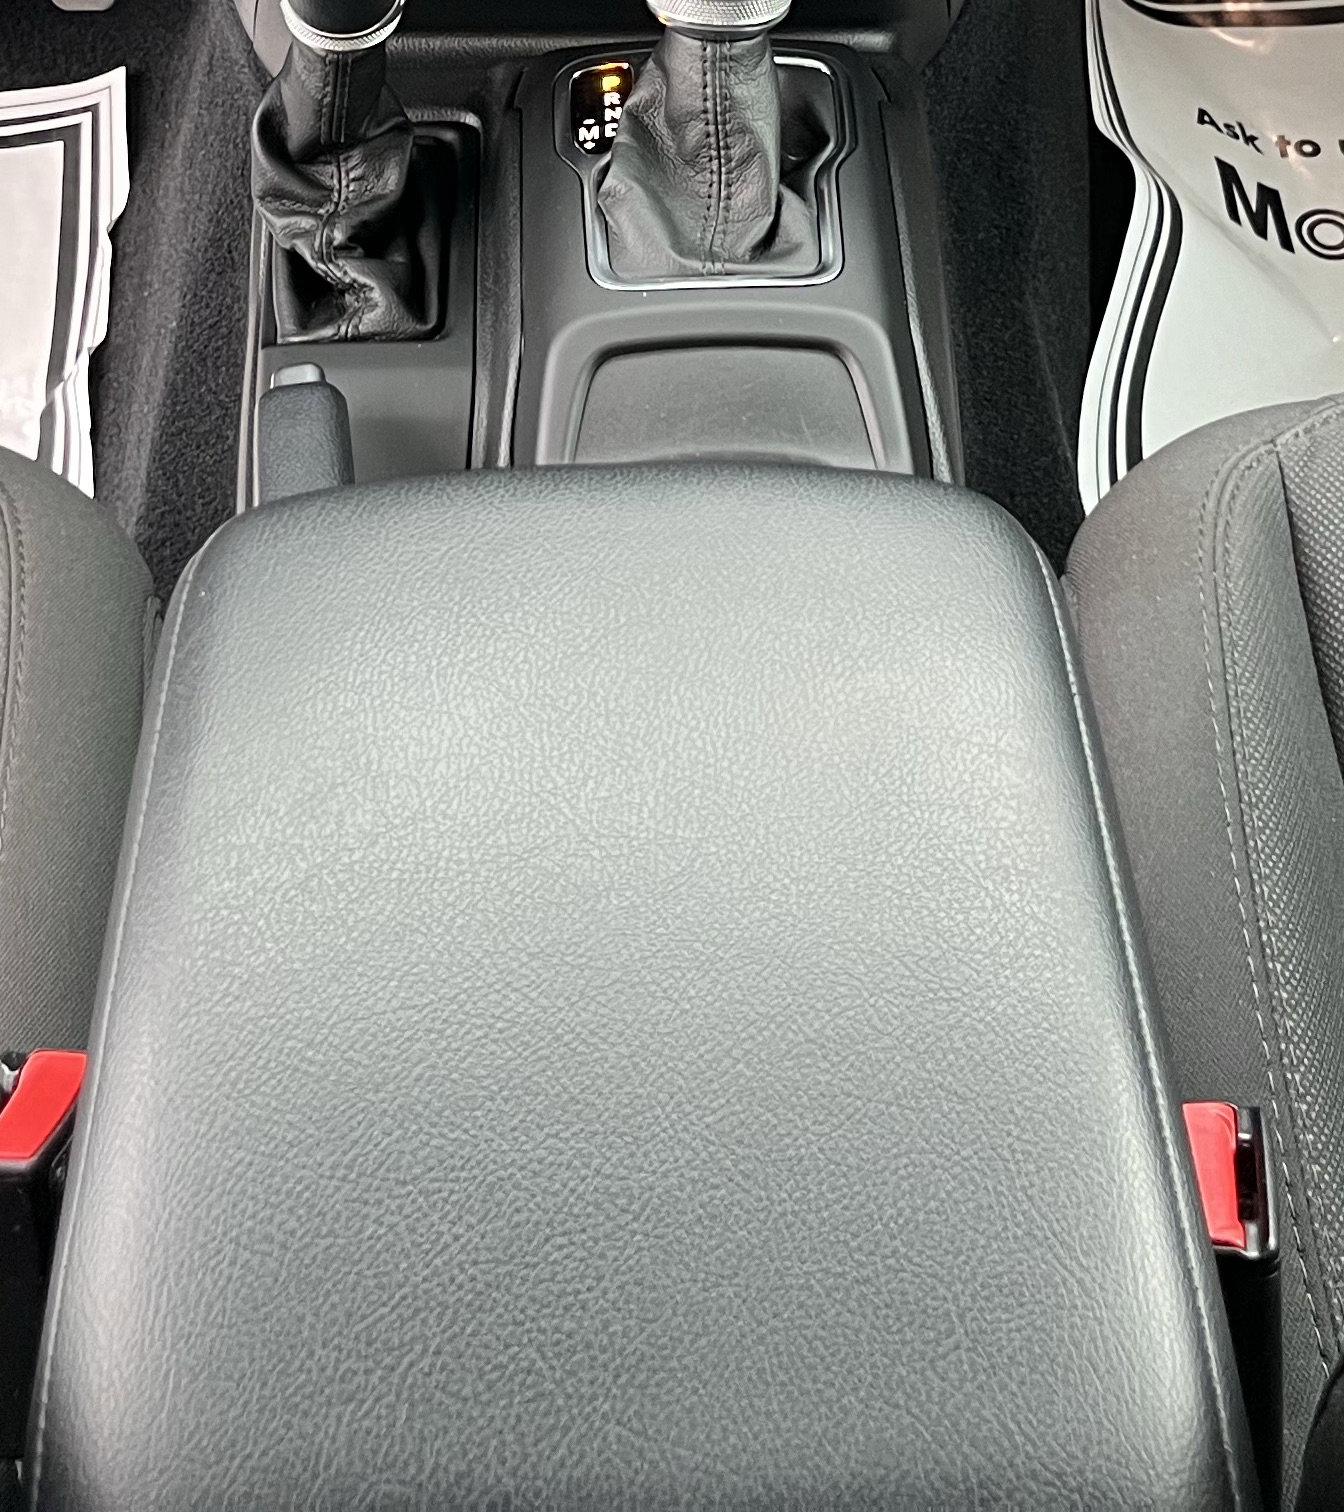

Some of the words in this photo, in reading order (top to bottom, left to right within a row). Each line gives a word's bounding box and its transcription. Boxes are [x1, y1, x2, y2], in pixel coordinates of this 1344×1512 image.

[602, 75, 621, 92] P
[603, 91, 621, 107] R
[604, 106, 623, 122] N
[578, 124, 600, 142] M
[1196, 106, 1265, 156] Ask
[1272, 134, 1322, 159] to
